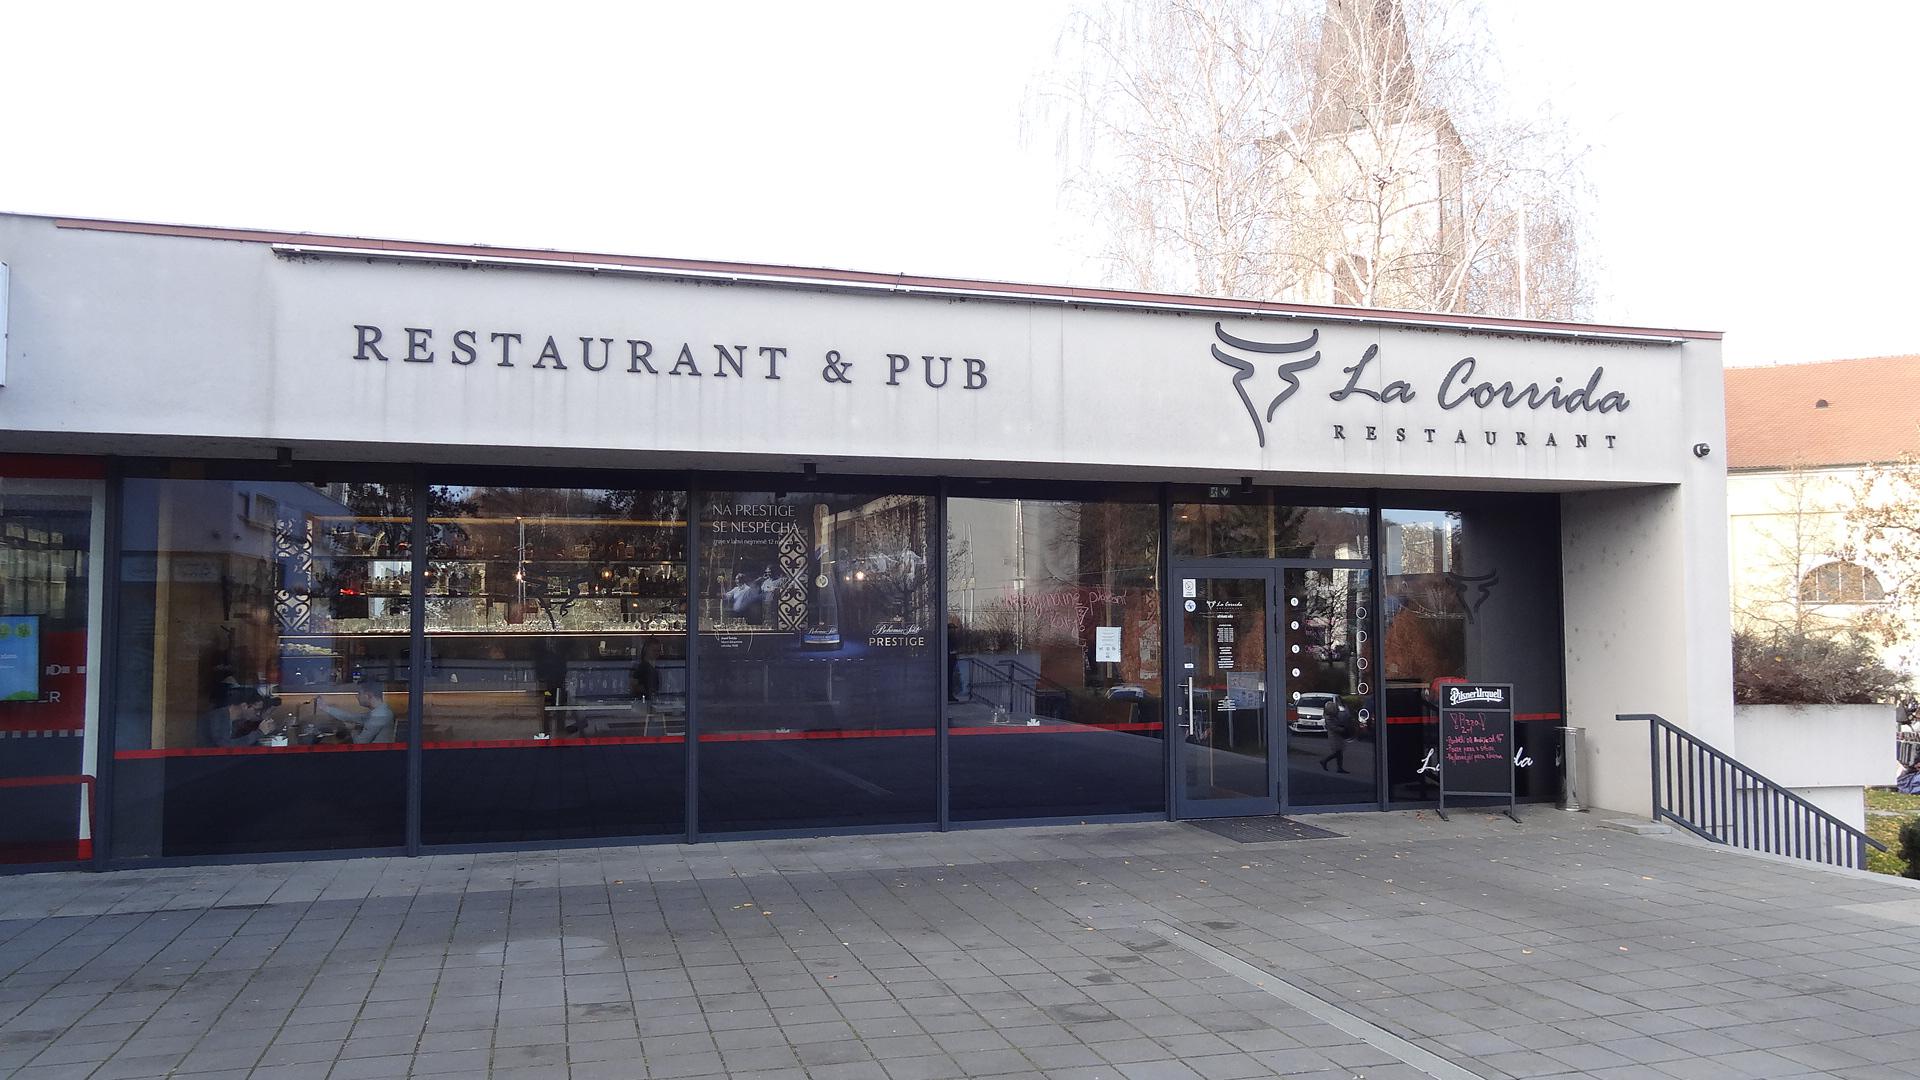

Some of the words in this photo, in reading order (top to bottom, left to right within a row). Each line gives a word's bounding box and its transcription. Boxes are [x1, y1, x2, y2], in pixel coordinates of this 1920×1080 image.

[352, 324, 787, 380] RESTAURANT
[822, 350, 853, 384] &
[885, 352, 989, 390] PUB
[1329, 343, 1416, 403] La
[1437, 356, 1630, 413] Corrida
[1333, 424, 1617, 449] RESTAURANT
[712, 504, 732, 516] NA
[735, 504, 796, 517] PRESTIGE
[712, 521, 728, 533] SE
[731, 519, 799, 534] NESPĚCHÁ
[868, 637, 925, 647] PRESTIGE
[1449, 687, 1477, 706] Pilsner
[1475, 687, 1503, 703] Urquell
